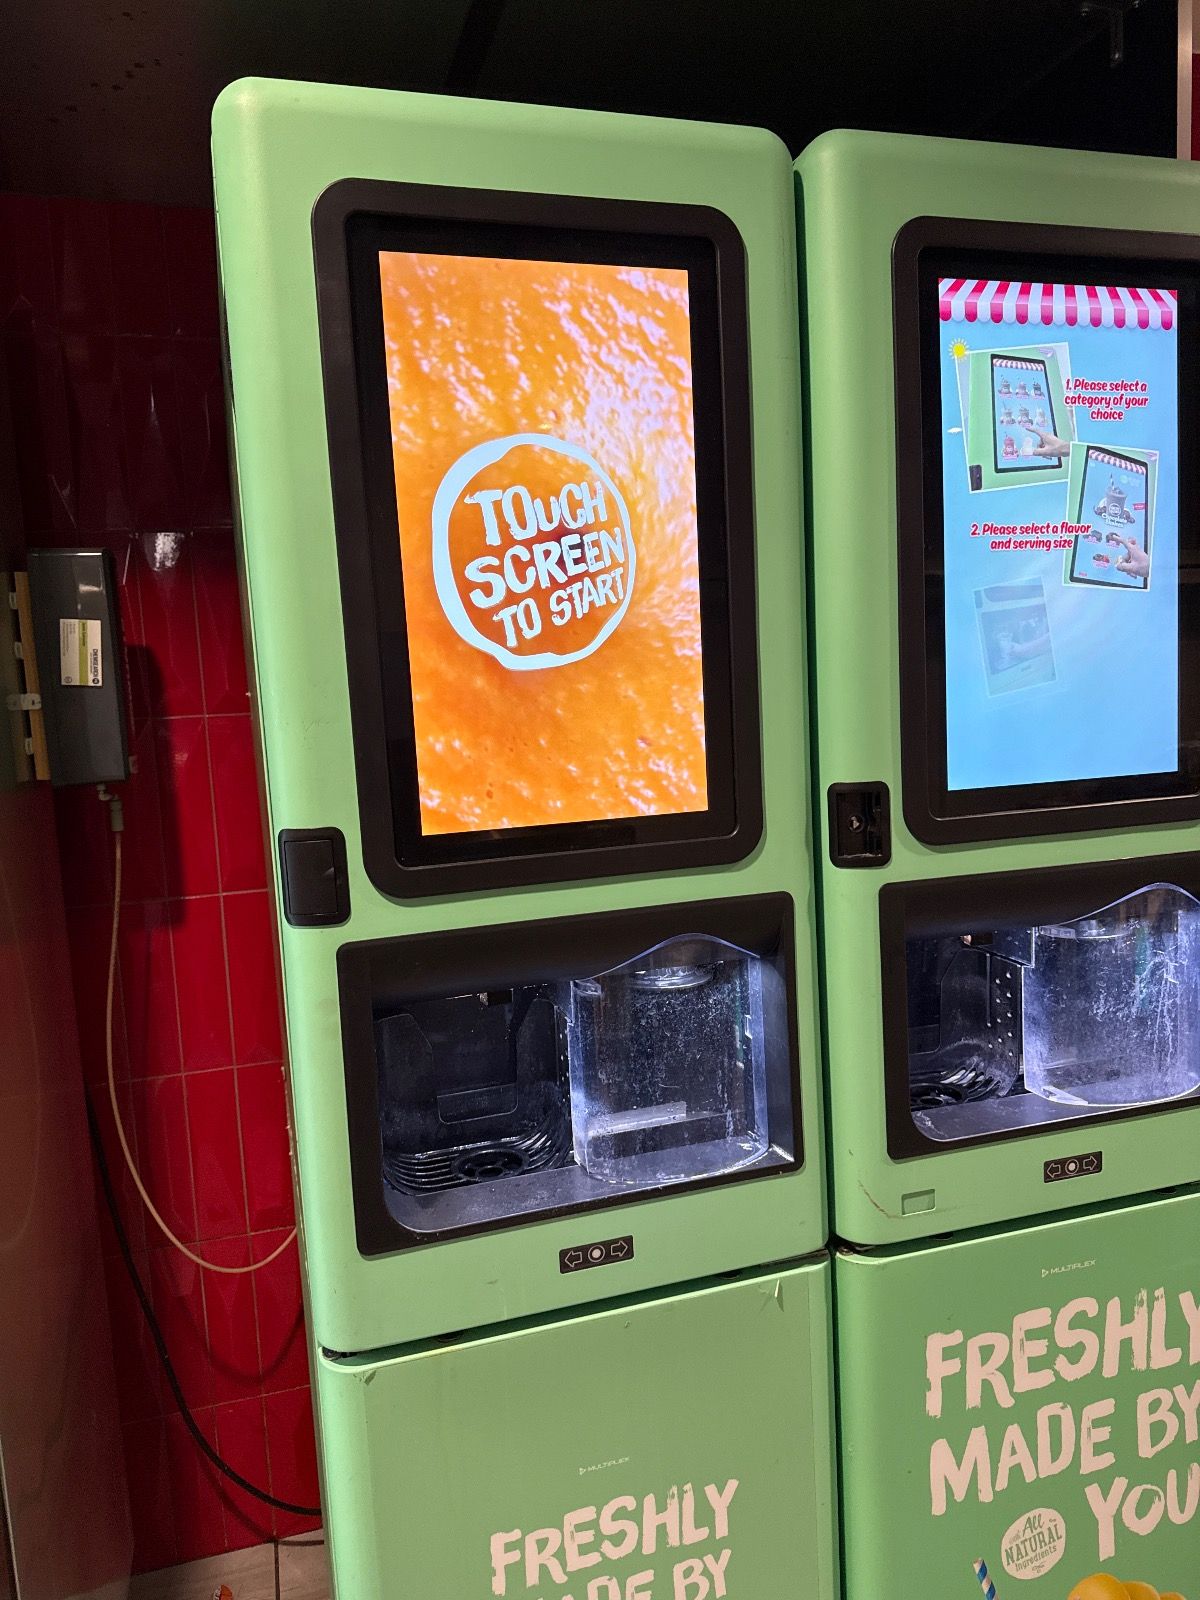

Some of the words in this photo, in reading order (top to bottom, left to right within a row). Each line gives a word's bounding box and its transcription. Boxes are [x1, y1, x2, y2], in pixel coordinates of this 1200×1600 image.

[1064, 393, 1111, 408] category
[1112, 393, 1124, 405] of
[1125, 397, 1148, 409] your
[1066, 379, 1072, 391] 1.
[1074, 378, 1108, 391] Please
[1109, 380, 1139, 392] select
[1140, 382, 1147, 392] a
[1090, 407, 1124, 420] choice
[464, 481, 608, 546] TOUCH
[971, 523, 980, 536] 2.
[982, 523, 1018, 536] Please
[1019, 522, 1051, 535] select
[1052, 526, 1059, 535] a
[1060, 521, 1092, 535] flavor
[990, 537, 1012, 550] and
[1013, 536, 1052, 552] serving
[1053, 535, 1073, 549] size
[464, 527, 625, 608] SCREEN
[493, 597, 542, 647] TO
[550, 567, 624, 626] START
[1051, 1259, 1096, 1275] MULTIPLEX
[930, 1398, 1116, 1516] MADE
[1137, 1379, 1200, 1459] BY
[1022, 1513, 1045, 1537] All
[1084, 1463, 1200, 1561] YOU
[490, 1478, 739, 1597] FRESHLY
[1005, 1523, 1062, 1567] NATURAL
[673, 1548, 732, 1600] BY
